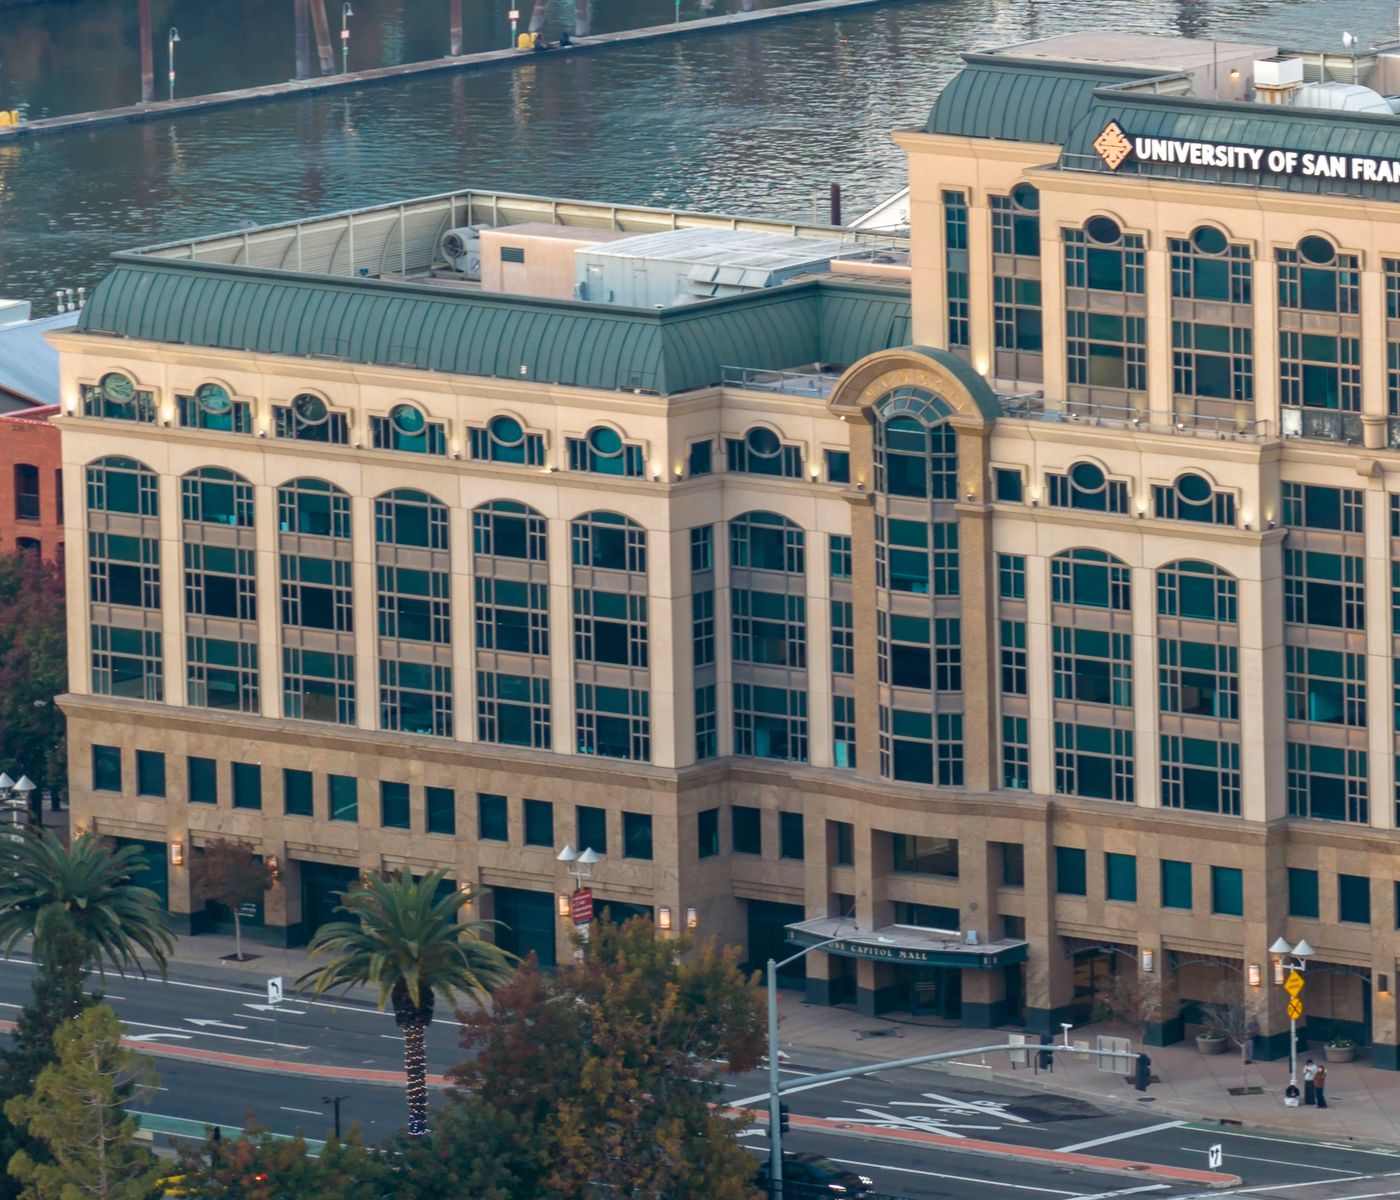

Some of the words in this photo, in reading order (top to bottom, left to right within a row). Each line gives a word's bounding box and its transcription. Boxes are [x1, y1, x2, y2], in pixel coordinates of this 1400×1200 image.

[1136, 138, 1264, 170] UNIVERSITY
[1268, 151, 1298, 174] OF
[1302, 153, 1347, 179] SAN
[827, 941, 846, 951] ONE
[850, 944, 893, 957] CAPITOL
[898, 950, 928, 961] MALL
